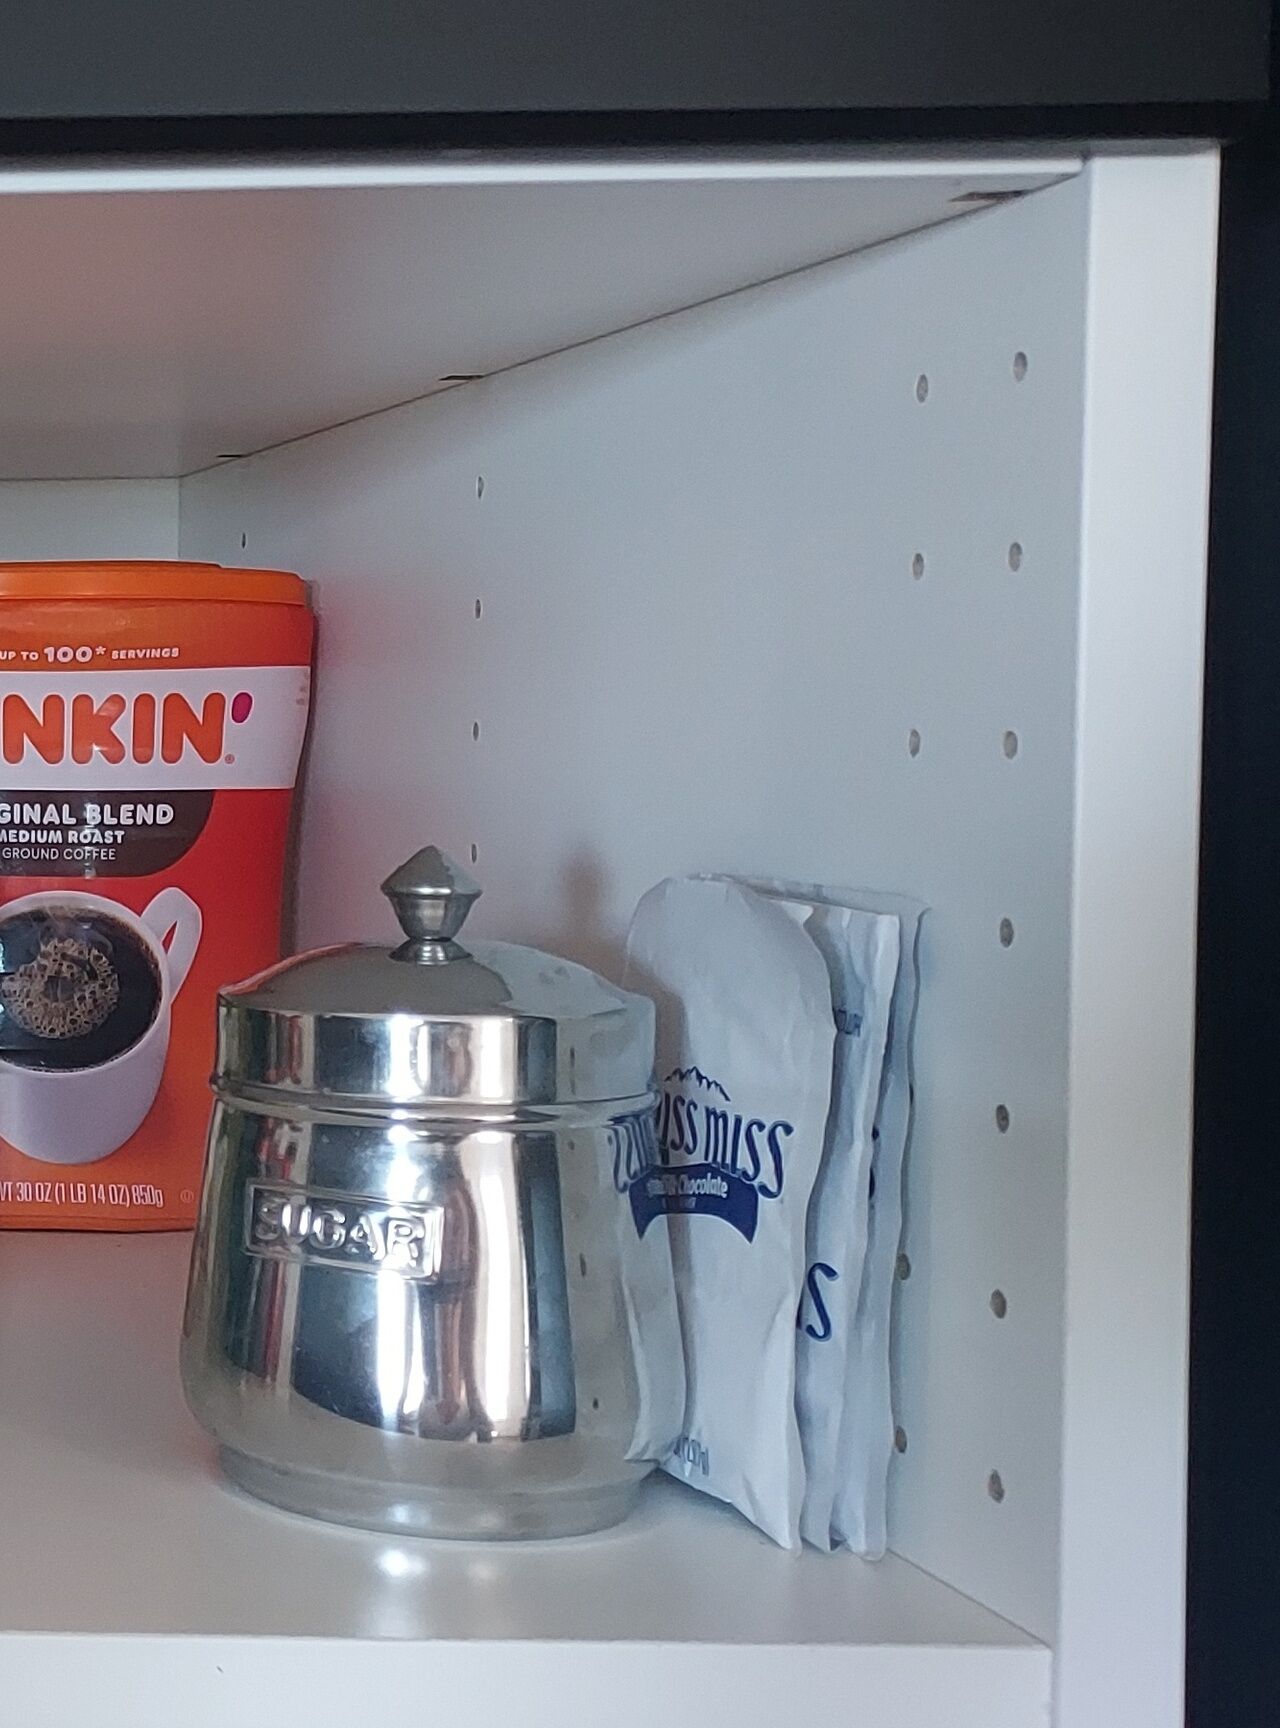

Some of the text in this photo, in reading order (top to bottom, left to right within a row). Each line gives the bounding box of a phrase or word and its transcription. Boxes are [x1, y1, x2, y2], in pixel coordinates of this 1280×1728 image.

[21, 650, 39, 661] TO
[111, 647, 180, 660] SERVINGS
[86, 803, 175, 825] BLEND
[69, 829, 125, 844] ROAST
[2, 847, 116, 861] GROUND COFFEE
[16, 1182, 32, 1202] 30
[35, 1182, 52, 1203] OZ
[55, 1183, 66, 1206] (1
[70, 1182, 87, 1204] LB
[90, 1183, 106, 1204] 14
[110, 1183, 130, 1208] OZ)
[132, 1184, 164, 1208] 850g
[253, 1195, 426, 1269] SUGAR
